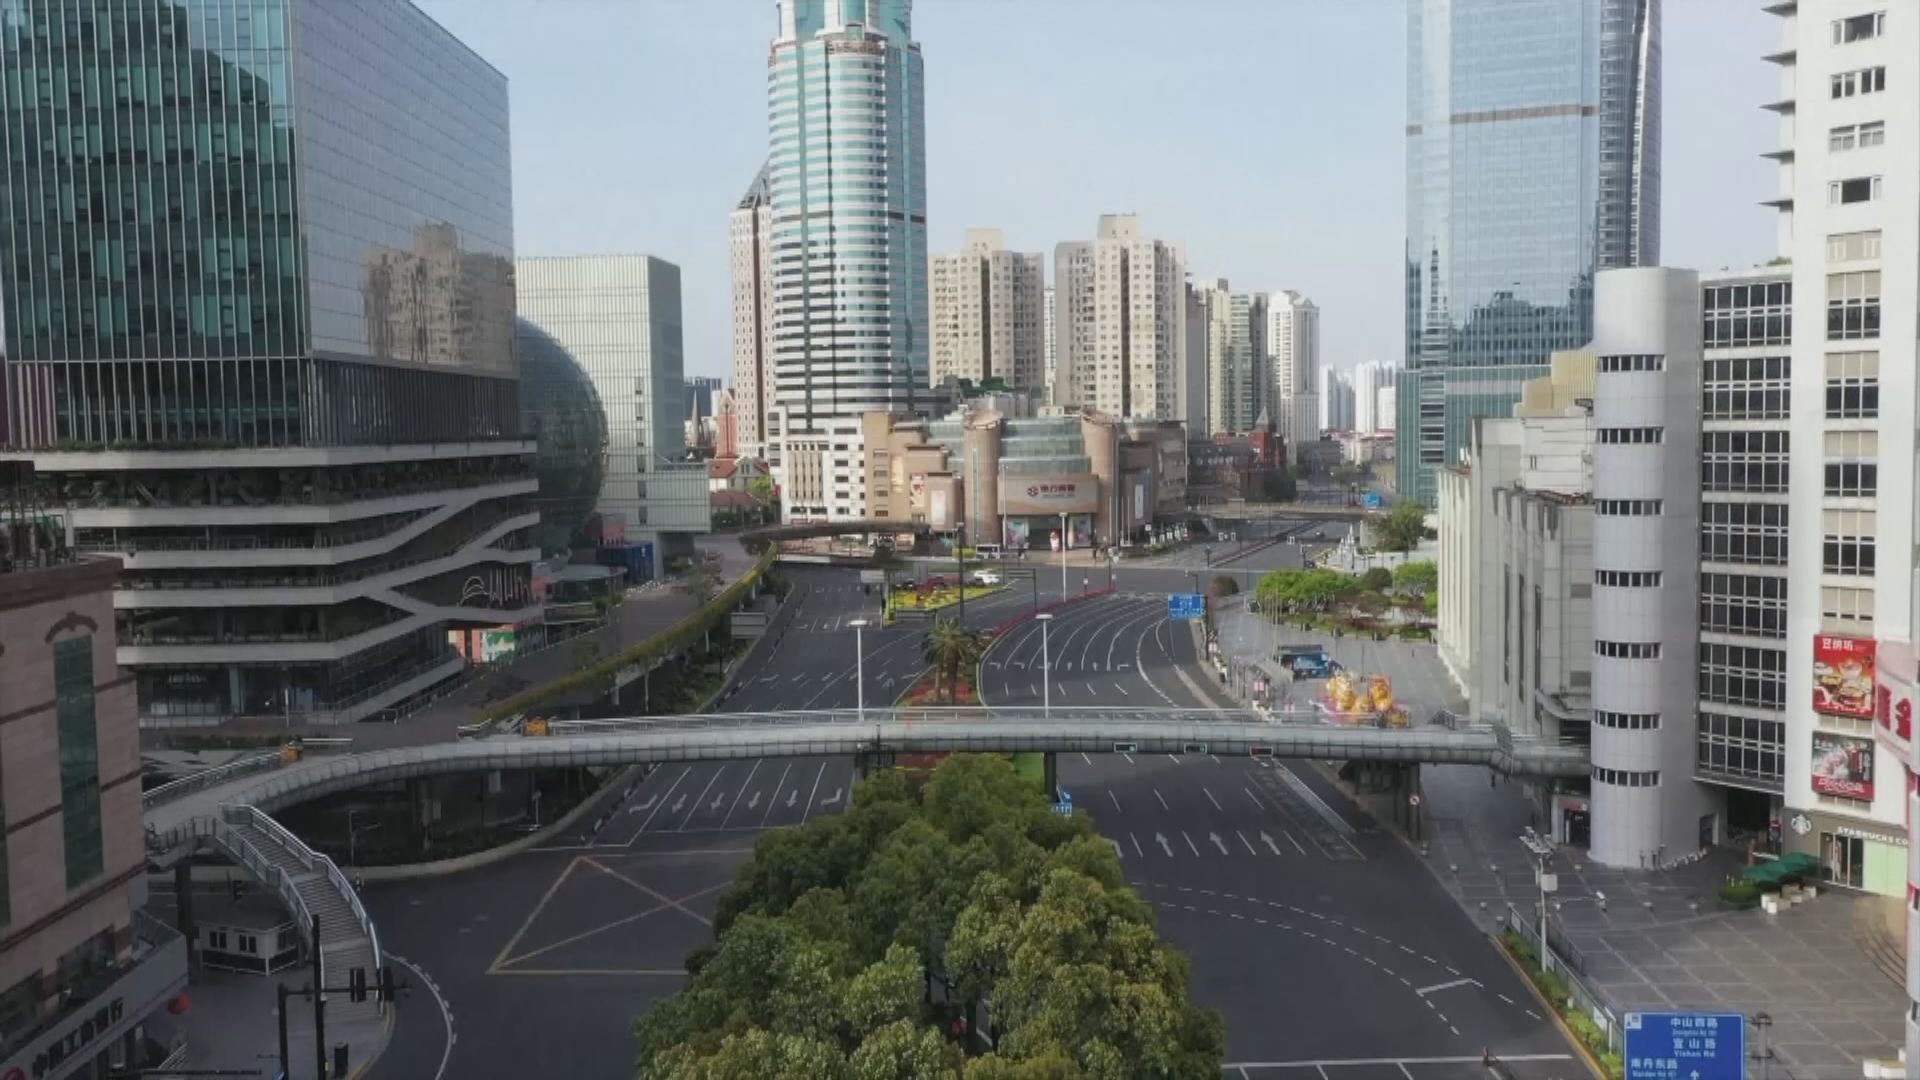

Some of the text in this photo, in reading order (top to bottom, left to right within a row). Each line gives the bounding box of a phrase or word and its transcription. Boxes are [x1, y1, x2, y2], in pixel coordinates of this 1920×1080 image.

[1838, 826, 1894, 843] STARBUCKS
[1670, 1018, 1718, 1028] 中山西路
[1673, 1038, 1716, 1049] 宜山路
[1631, 1058, 1678, 1069] 南丹东路
